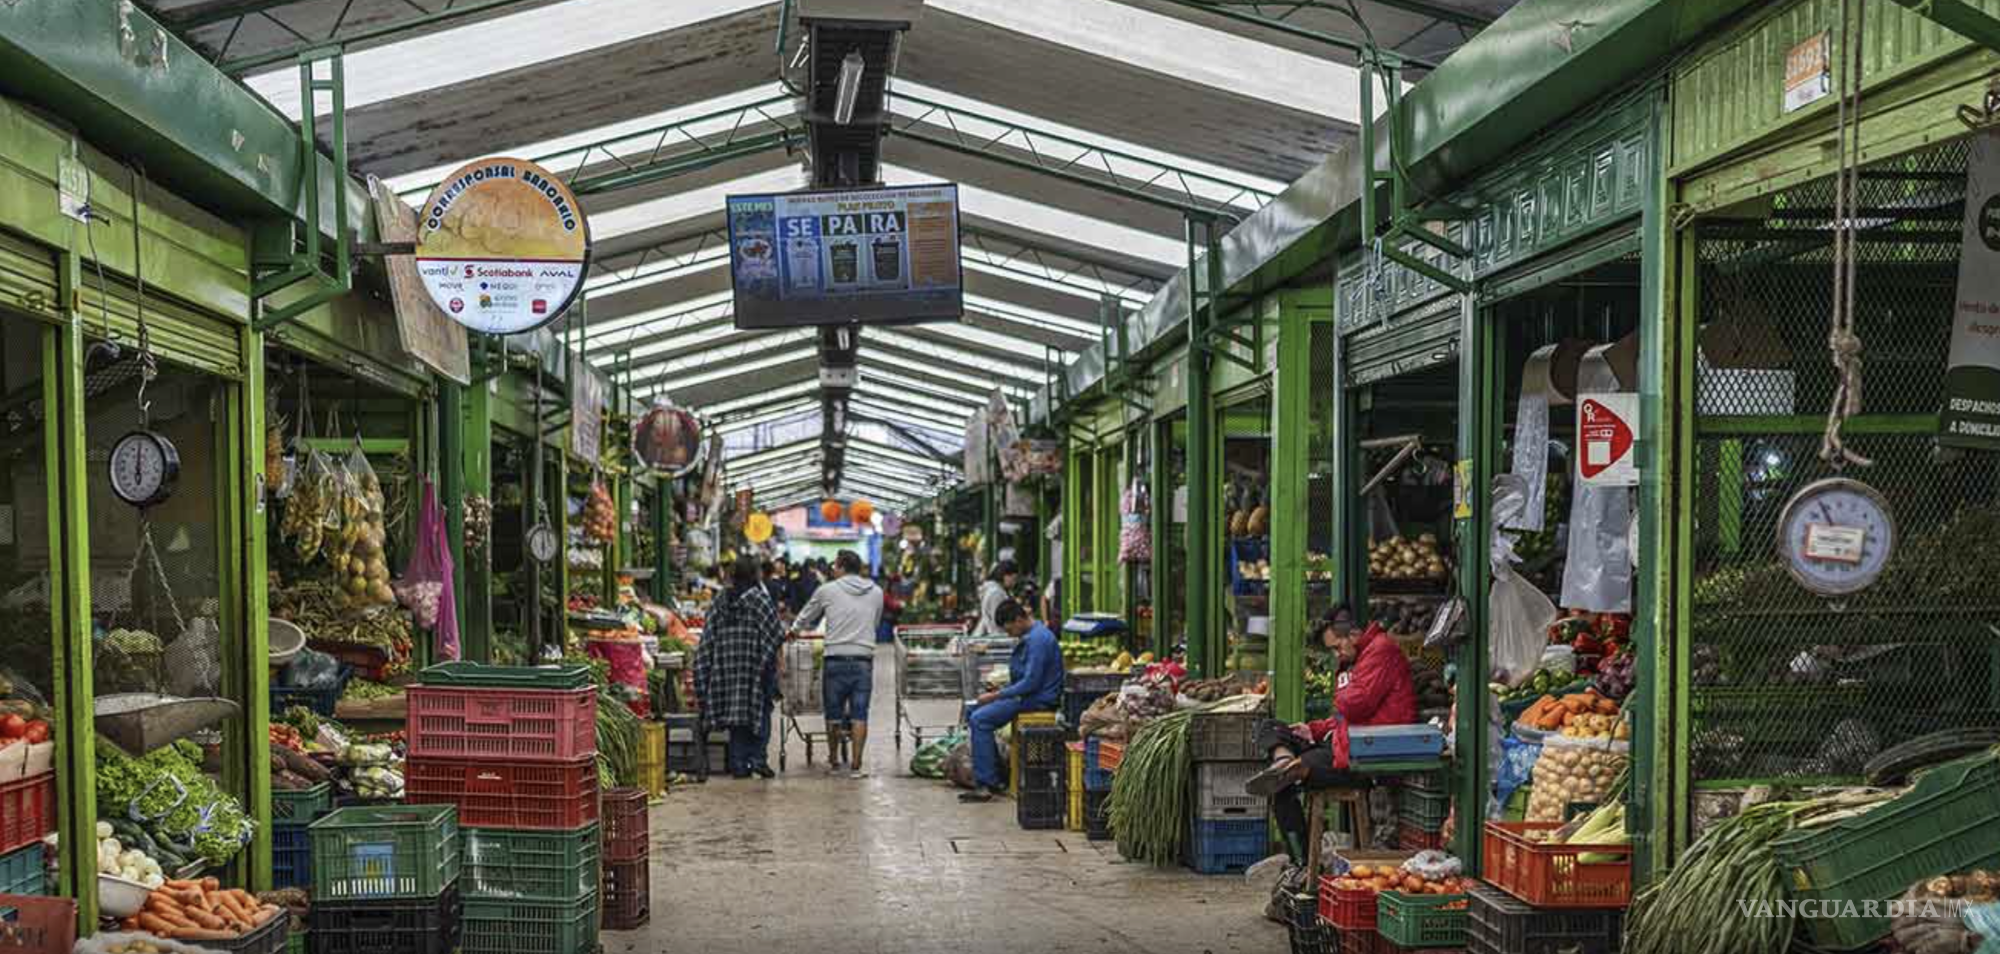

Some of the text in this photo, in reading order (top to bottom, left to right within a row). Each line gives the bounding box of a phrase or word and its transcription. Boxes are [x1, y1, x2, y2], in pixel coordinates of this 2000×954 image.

[787, 218, 813, 236] SE
[828, 216, 857, 234] PA
[870, 214, 900, 232] RA
[477, 267, 533, 278] Scotiabank
[539, 269, 575, 278] AVAL
[1949, 420, 1957, 433] A
